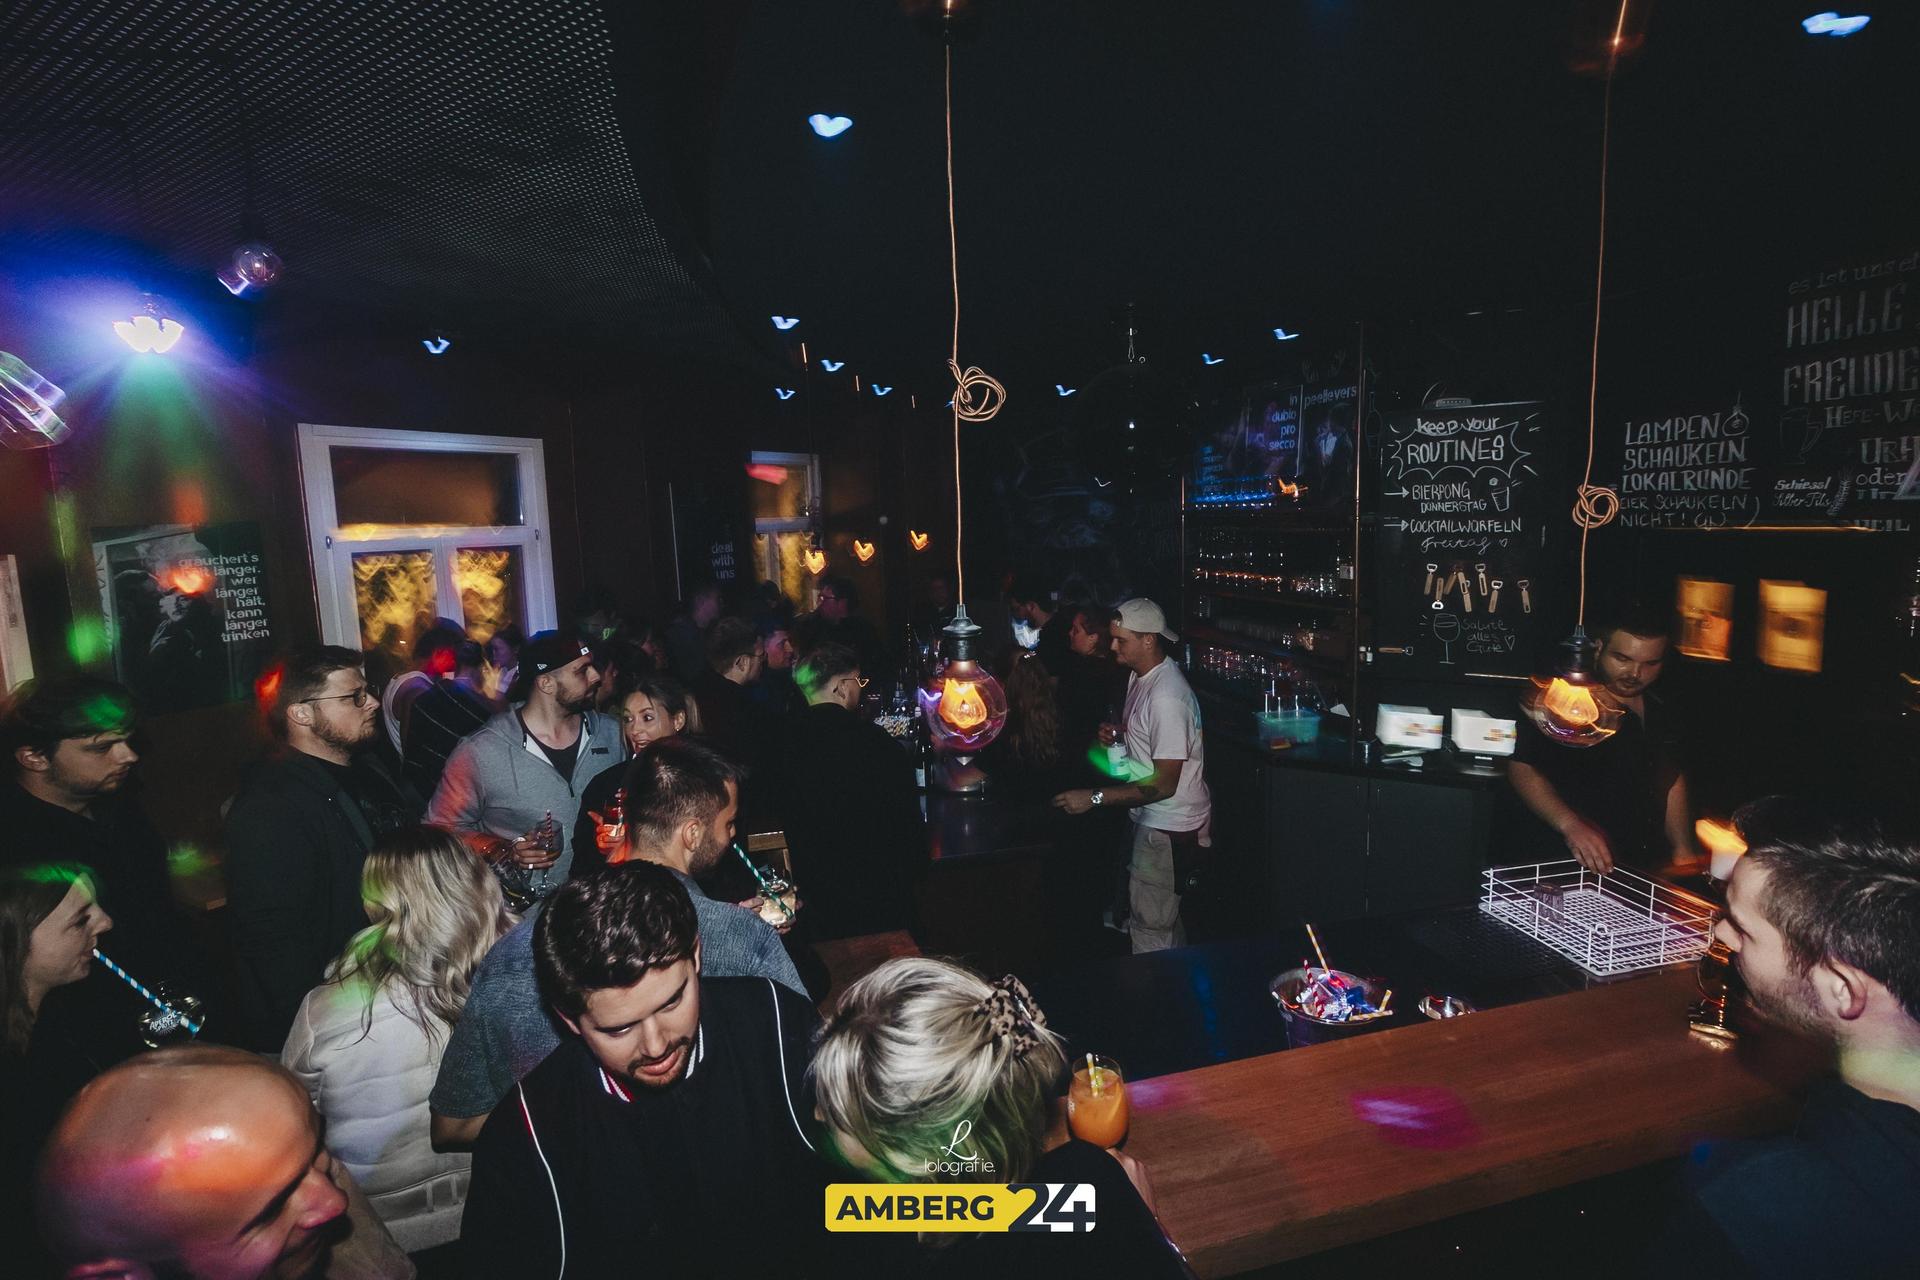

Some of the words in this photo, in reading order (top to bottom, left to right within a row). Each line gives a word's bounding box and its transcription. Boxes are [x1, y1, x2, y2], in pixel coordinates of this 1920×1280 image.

[1280, 425, 1296, 438] pro
[1624, 413, 1721, 446] LAMPEN
[1623, 436, 1750, 472] SCHAUKELN
[1621, 467, 1757, 494] LOKALRUNDE
[1411, 481, 1471, 500] BIERPONG
[1420, 499, 1488, 514] DONNERSTAG
[226, 608, 263, 620] kann
[221, 629, 270, 642] trinken
